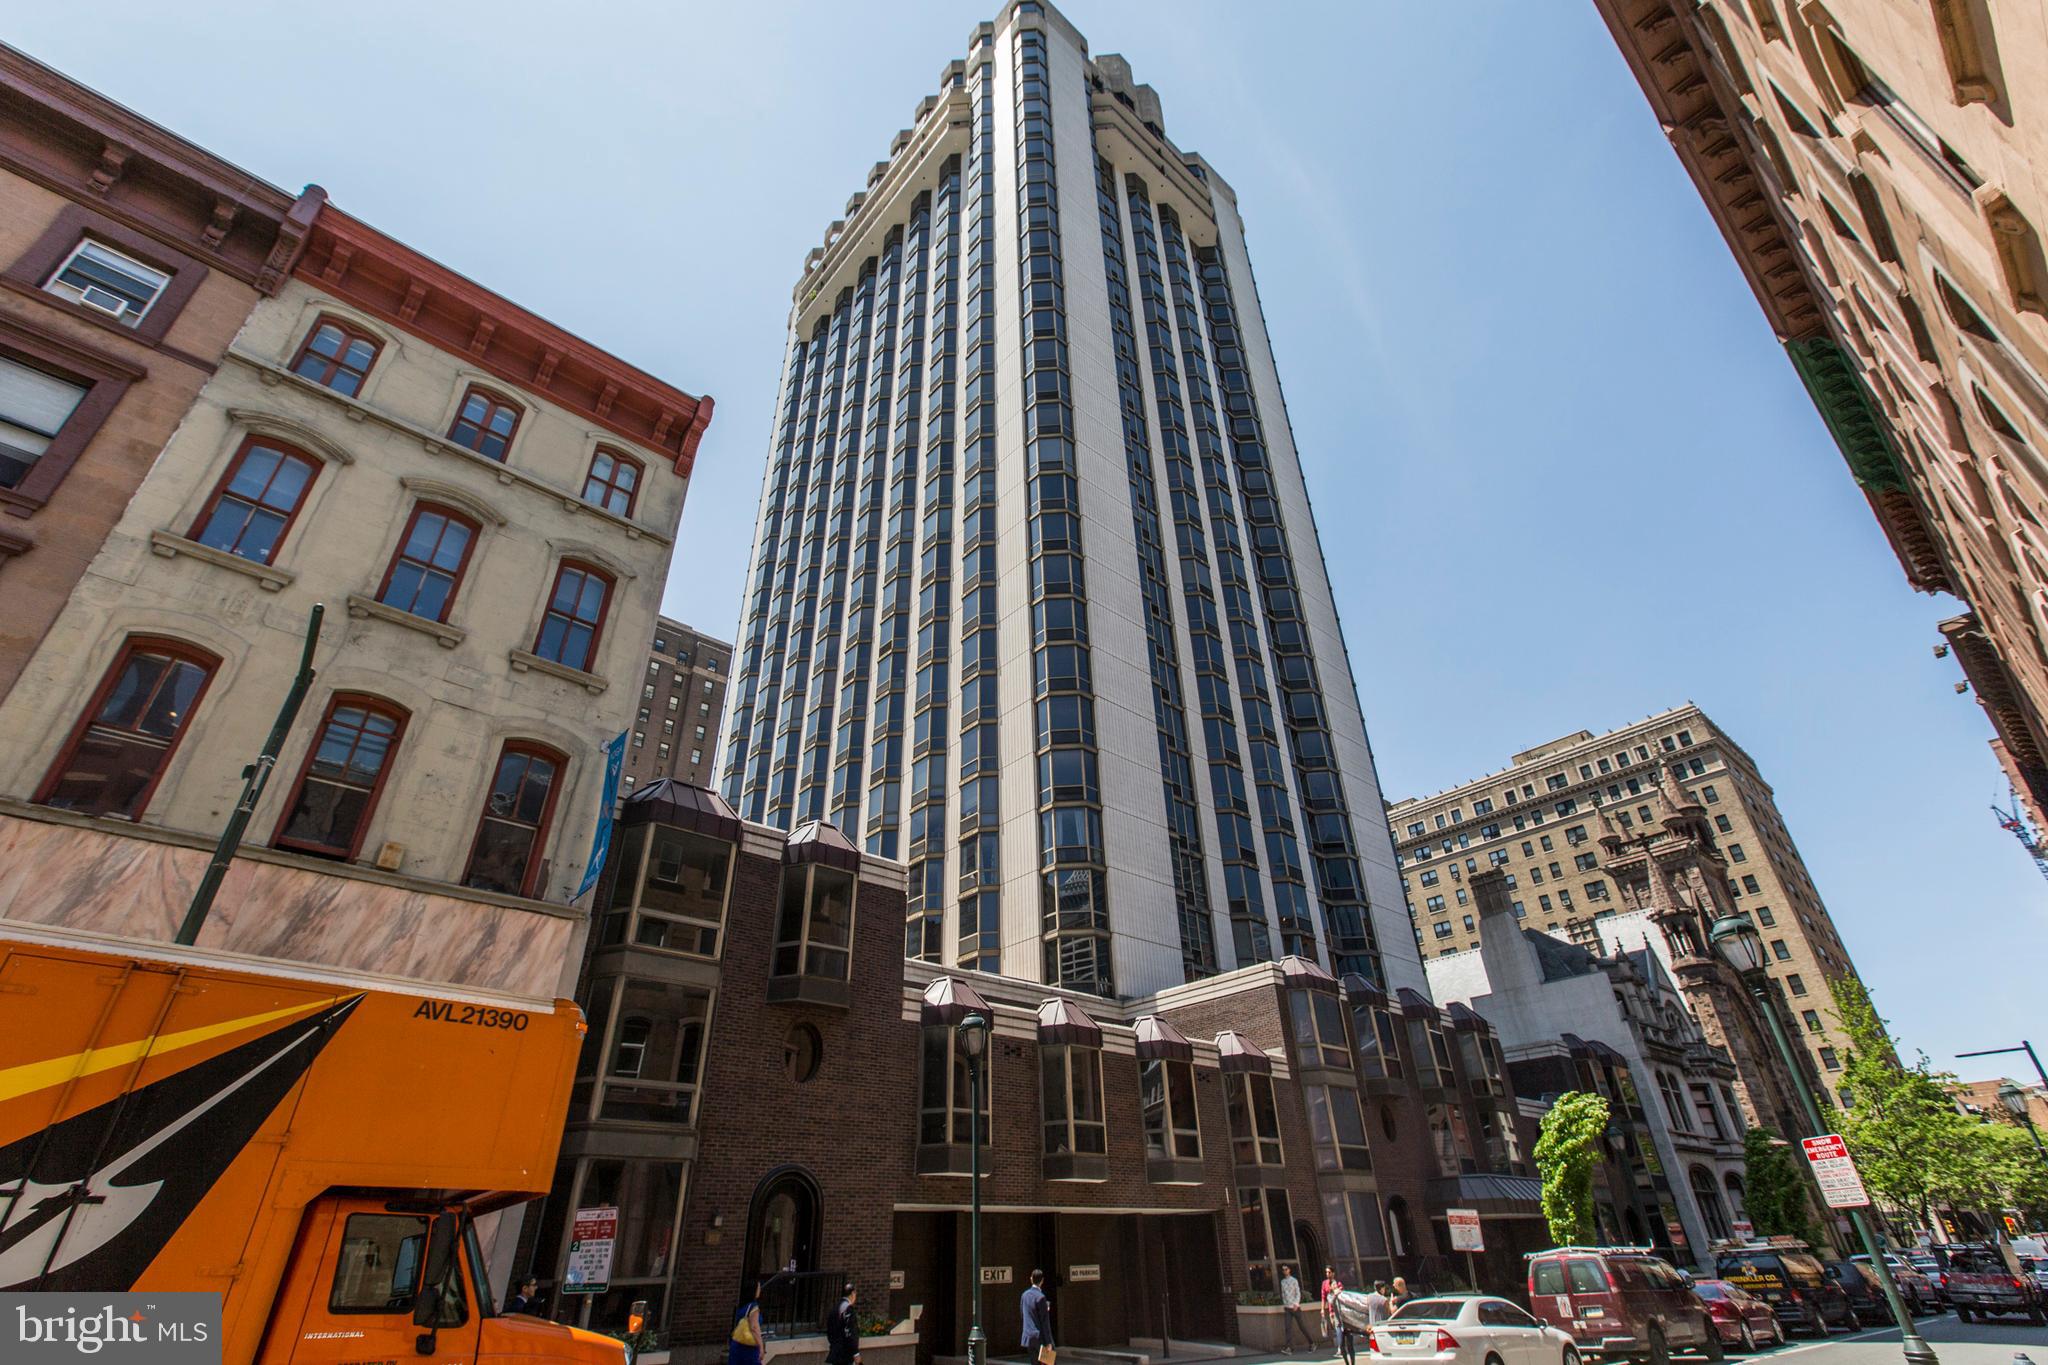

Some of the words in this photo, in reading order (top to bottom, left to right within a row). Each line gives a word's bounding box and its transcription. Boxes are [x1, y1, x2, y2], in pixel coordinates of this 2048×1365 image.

[412, 1000, 529, 1031] AVL21390
[1811, 1138, 1832, 1147] SNOW
[1806, 1144, 1842, 1154] EMERGENCY
[1815, 1151, 1839, 1159] ROUTE
[572, 1241, 579, 1251] 2
[983, 1270, 1006, 1281] EXIT
[304, 1331, 365, 1339] INTERNATIONAL
